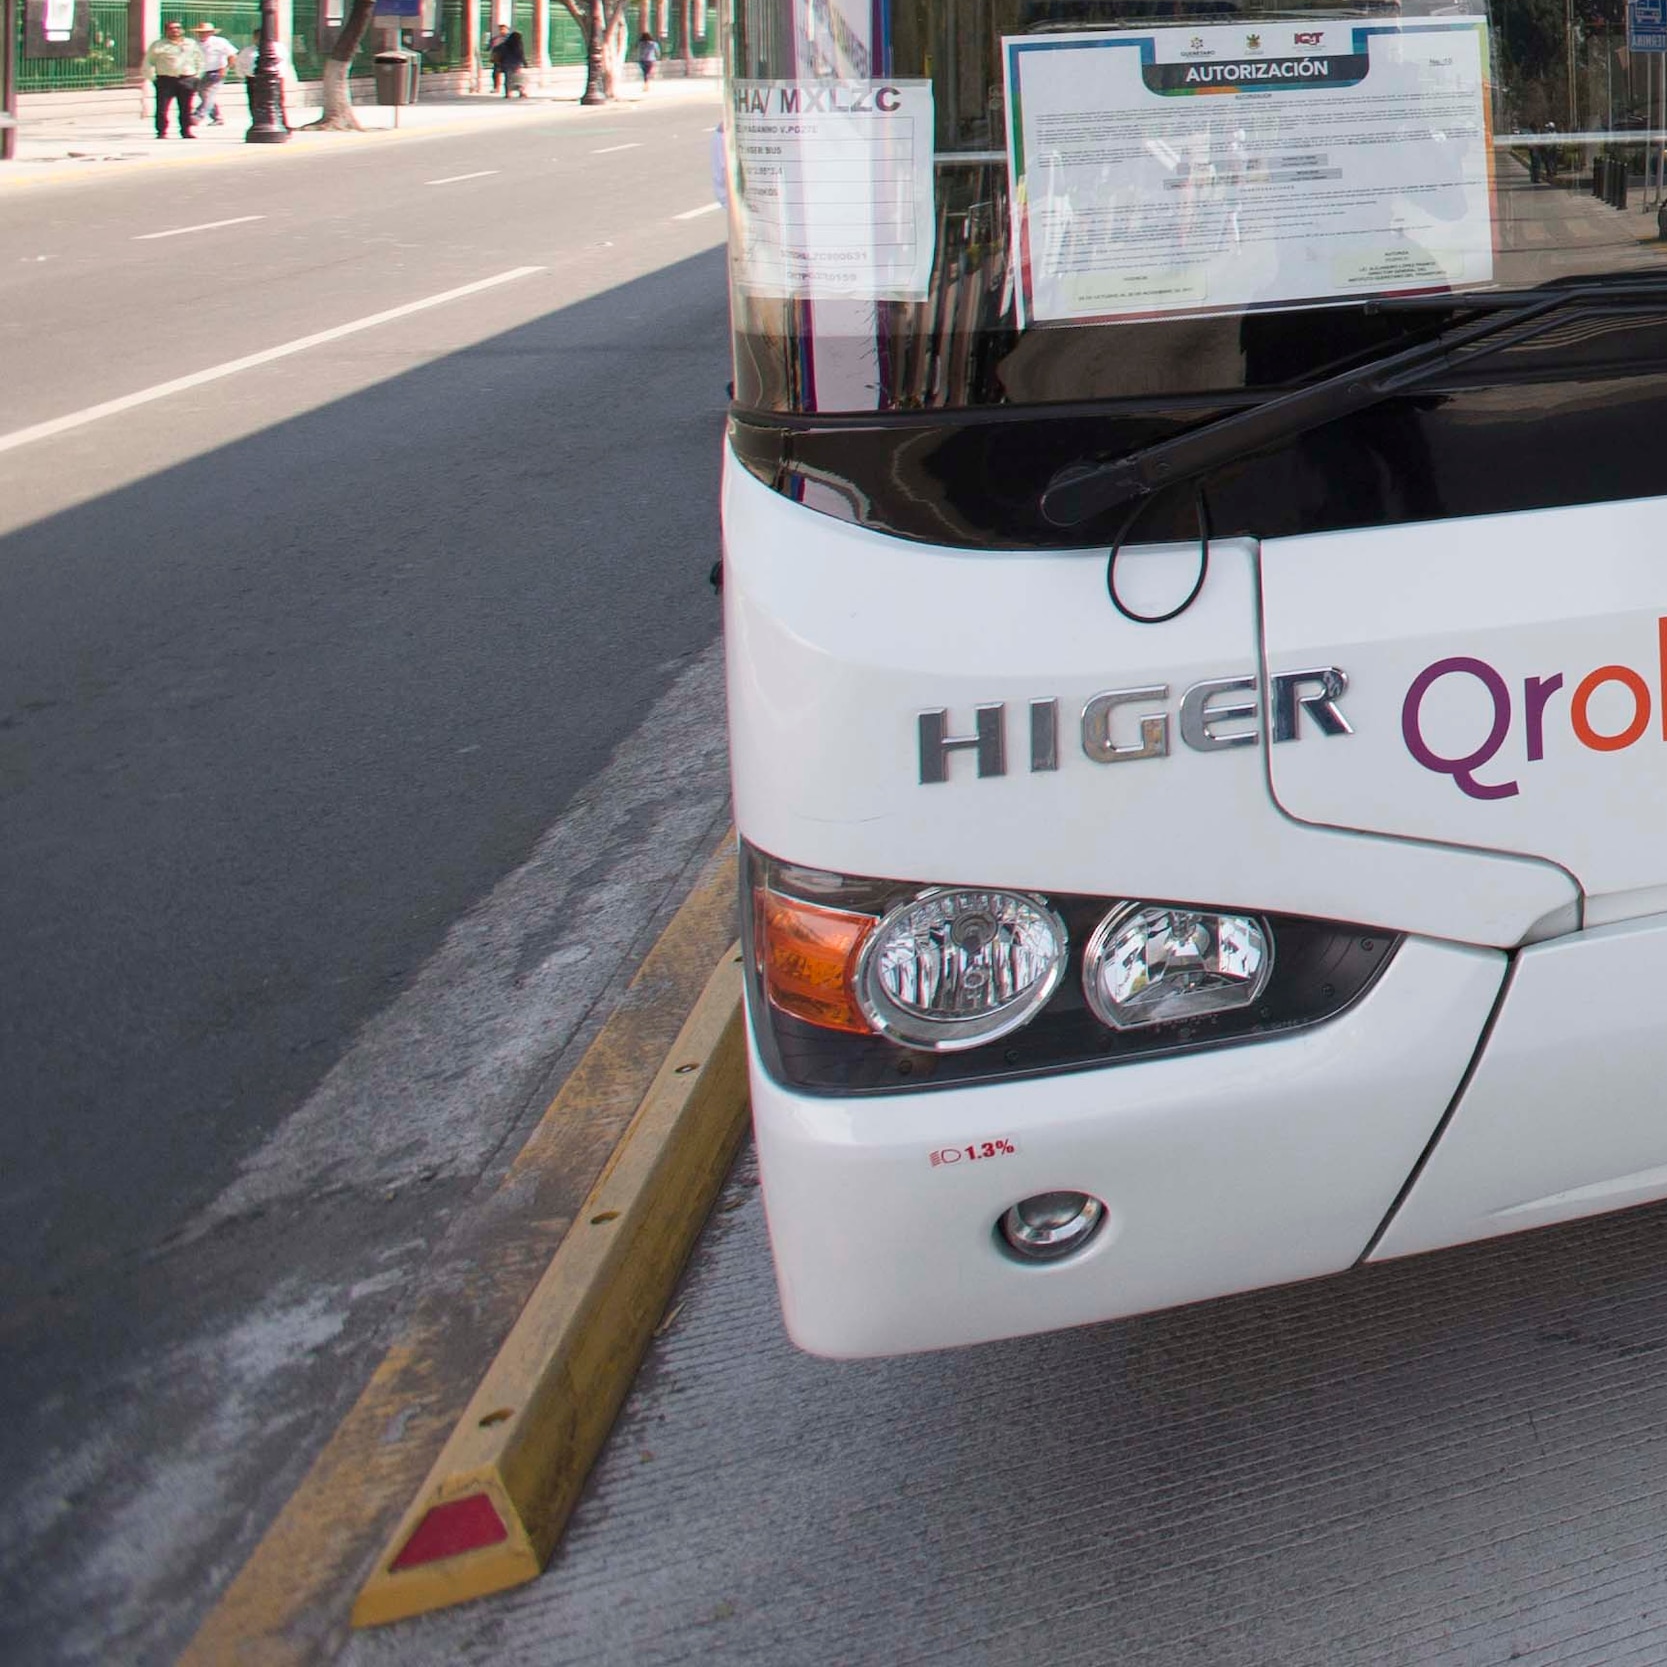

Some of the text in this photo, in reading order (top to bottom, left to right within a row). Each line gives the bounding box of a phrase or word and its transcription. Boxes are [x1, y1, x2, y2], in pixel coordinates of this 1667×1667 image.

[1185, 58, 1329, 82] AUTORIZACIÓN
[916, 664, 1355, 787] HIGER
[965, 1138, 1015, 1162] 1.3%
